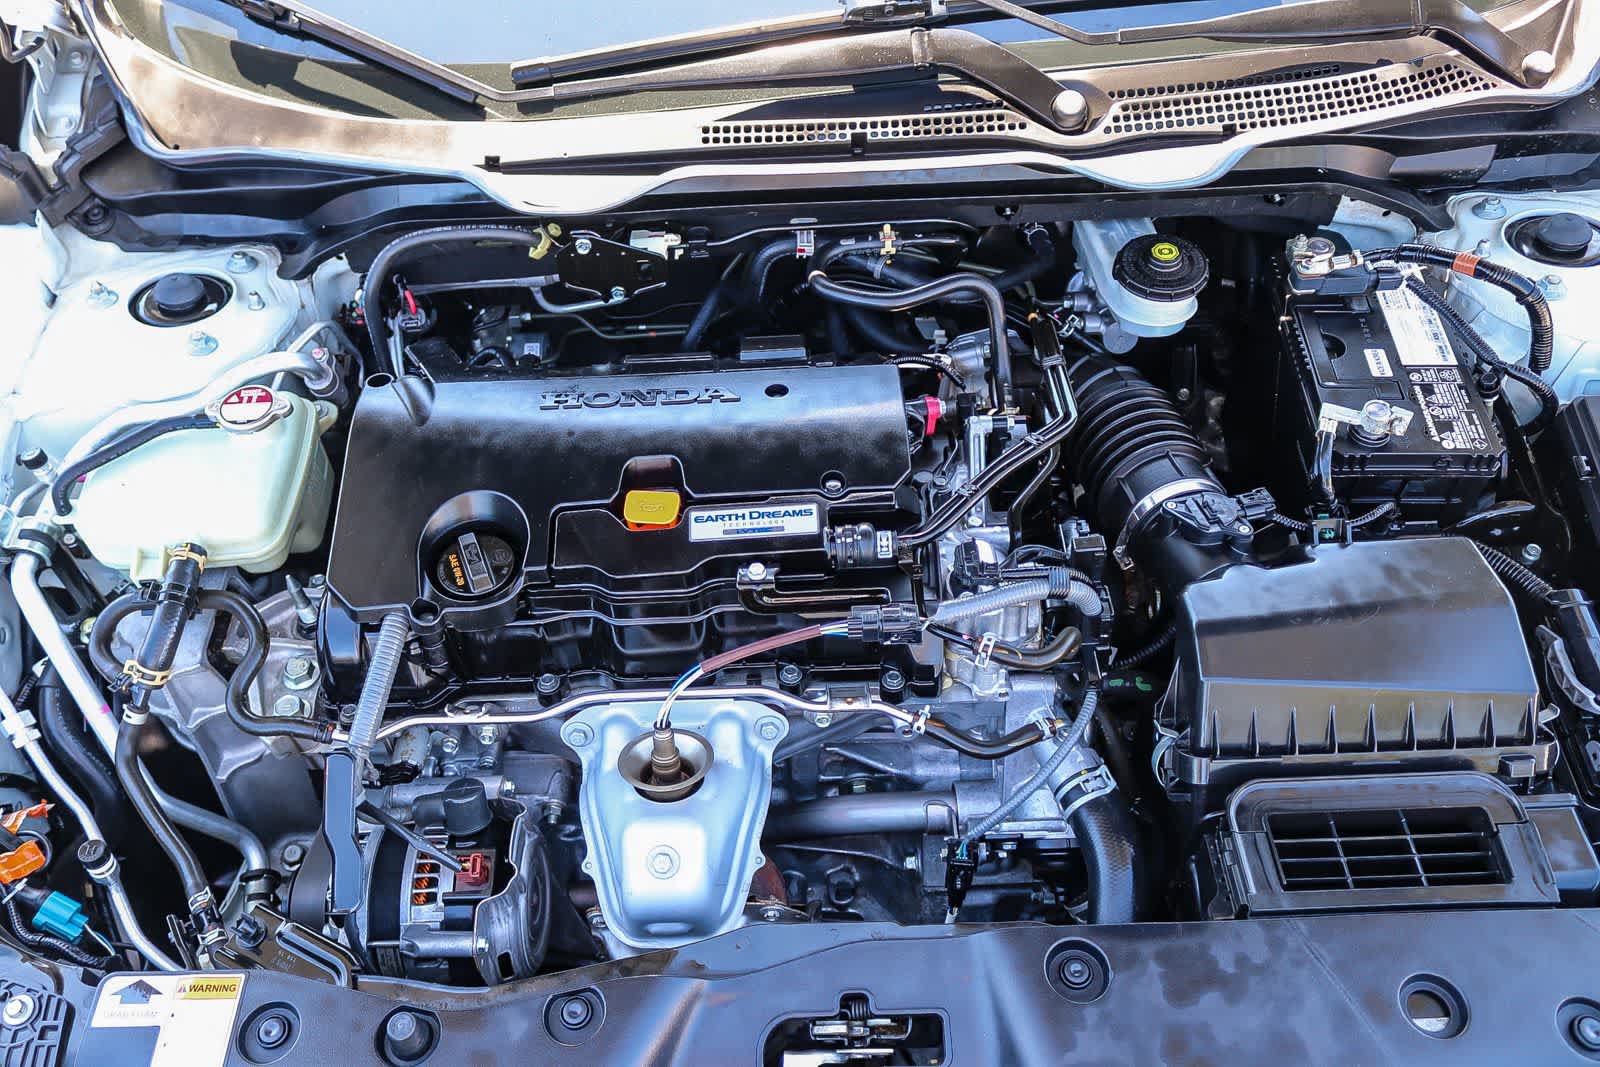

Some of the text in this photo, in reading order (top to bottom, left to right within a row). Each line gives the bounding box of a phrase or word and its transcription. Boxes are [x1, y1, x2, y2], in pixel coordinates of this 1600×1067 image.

[539, 387, 742, 410] HONDA
[694, 508, 814, 523] EARTH DREAMS
[189, 984, 237, 993] WARNING
